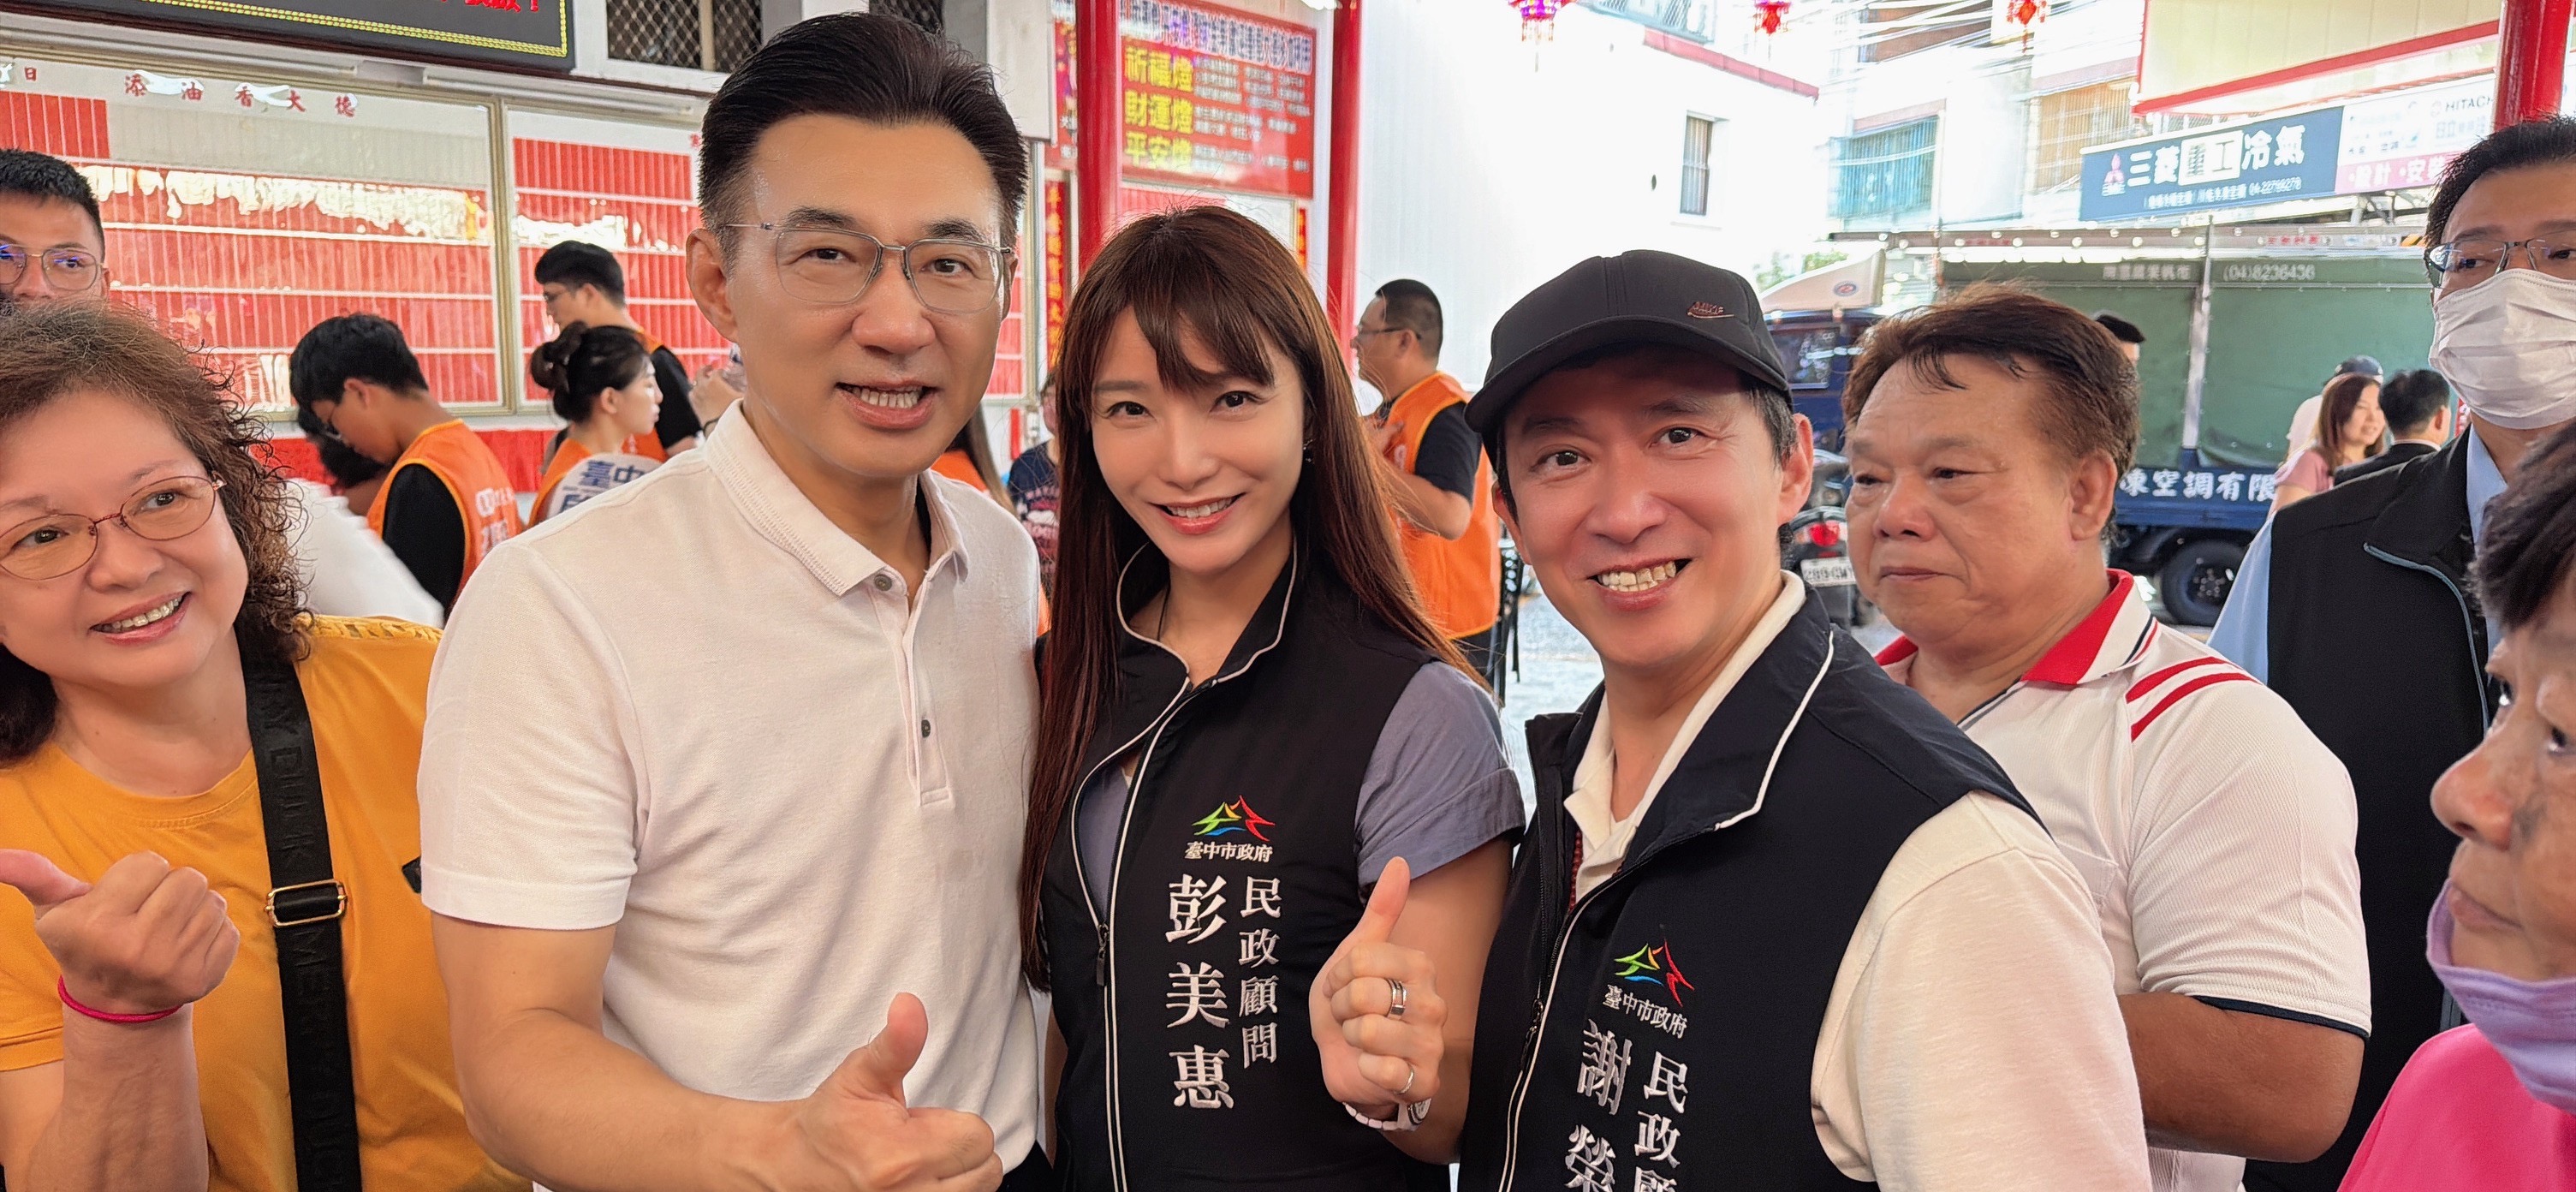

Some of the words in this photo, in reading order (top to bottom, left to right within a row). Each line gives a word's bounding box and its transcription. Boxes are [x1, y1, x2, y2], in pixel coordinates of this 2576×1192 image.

[1124, 45, 1193, 92] 祈福燈
[1124, 89, 1194, 134] 財運燈
[1124, 130, 1193, 170] 平安燈
[2127, 124, 2305, 187] 三菱重工冷氣
[1185, 841, 1273, 863] 臺中市政府
[1165, 873, 1234, 1110] 彭美惠
[1238, 875, 1282, 1069] 民政顧問
[1603, 984, 1688, 1039] 臺中市政府
